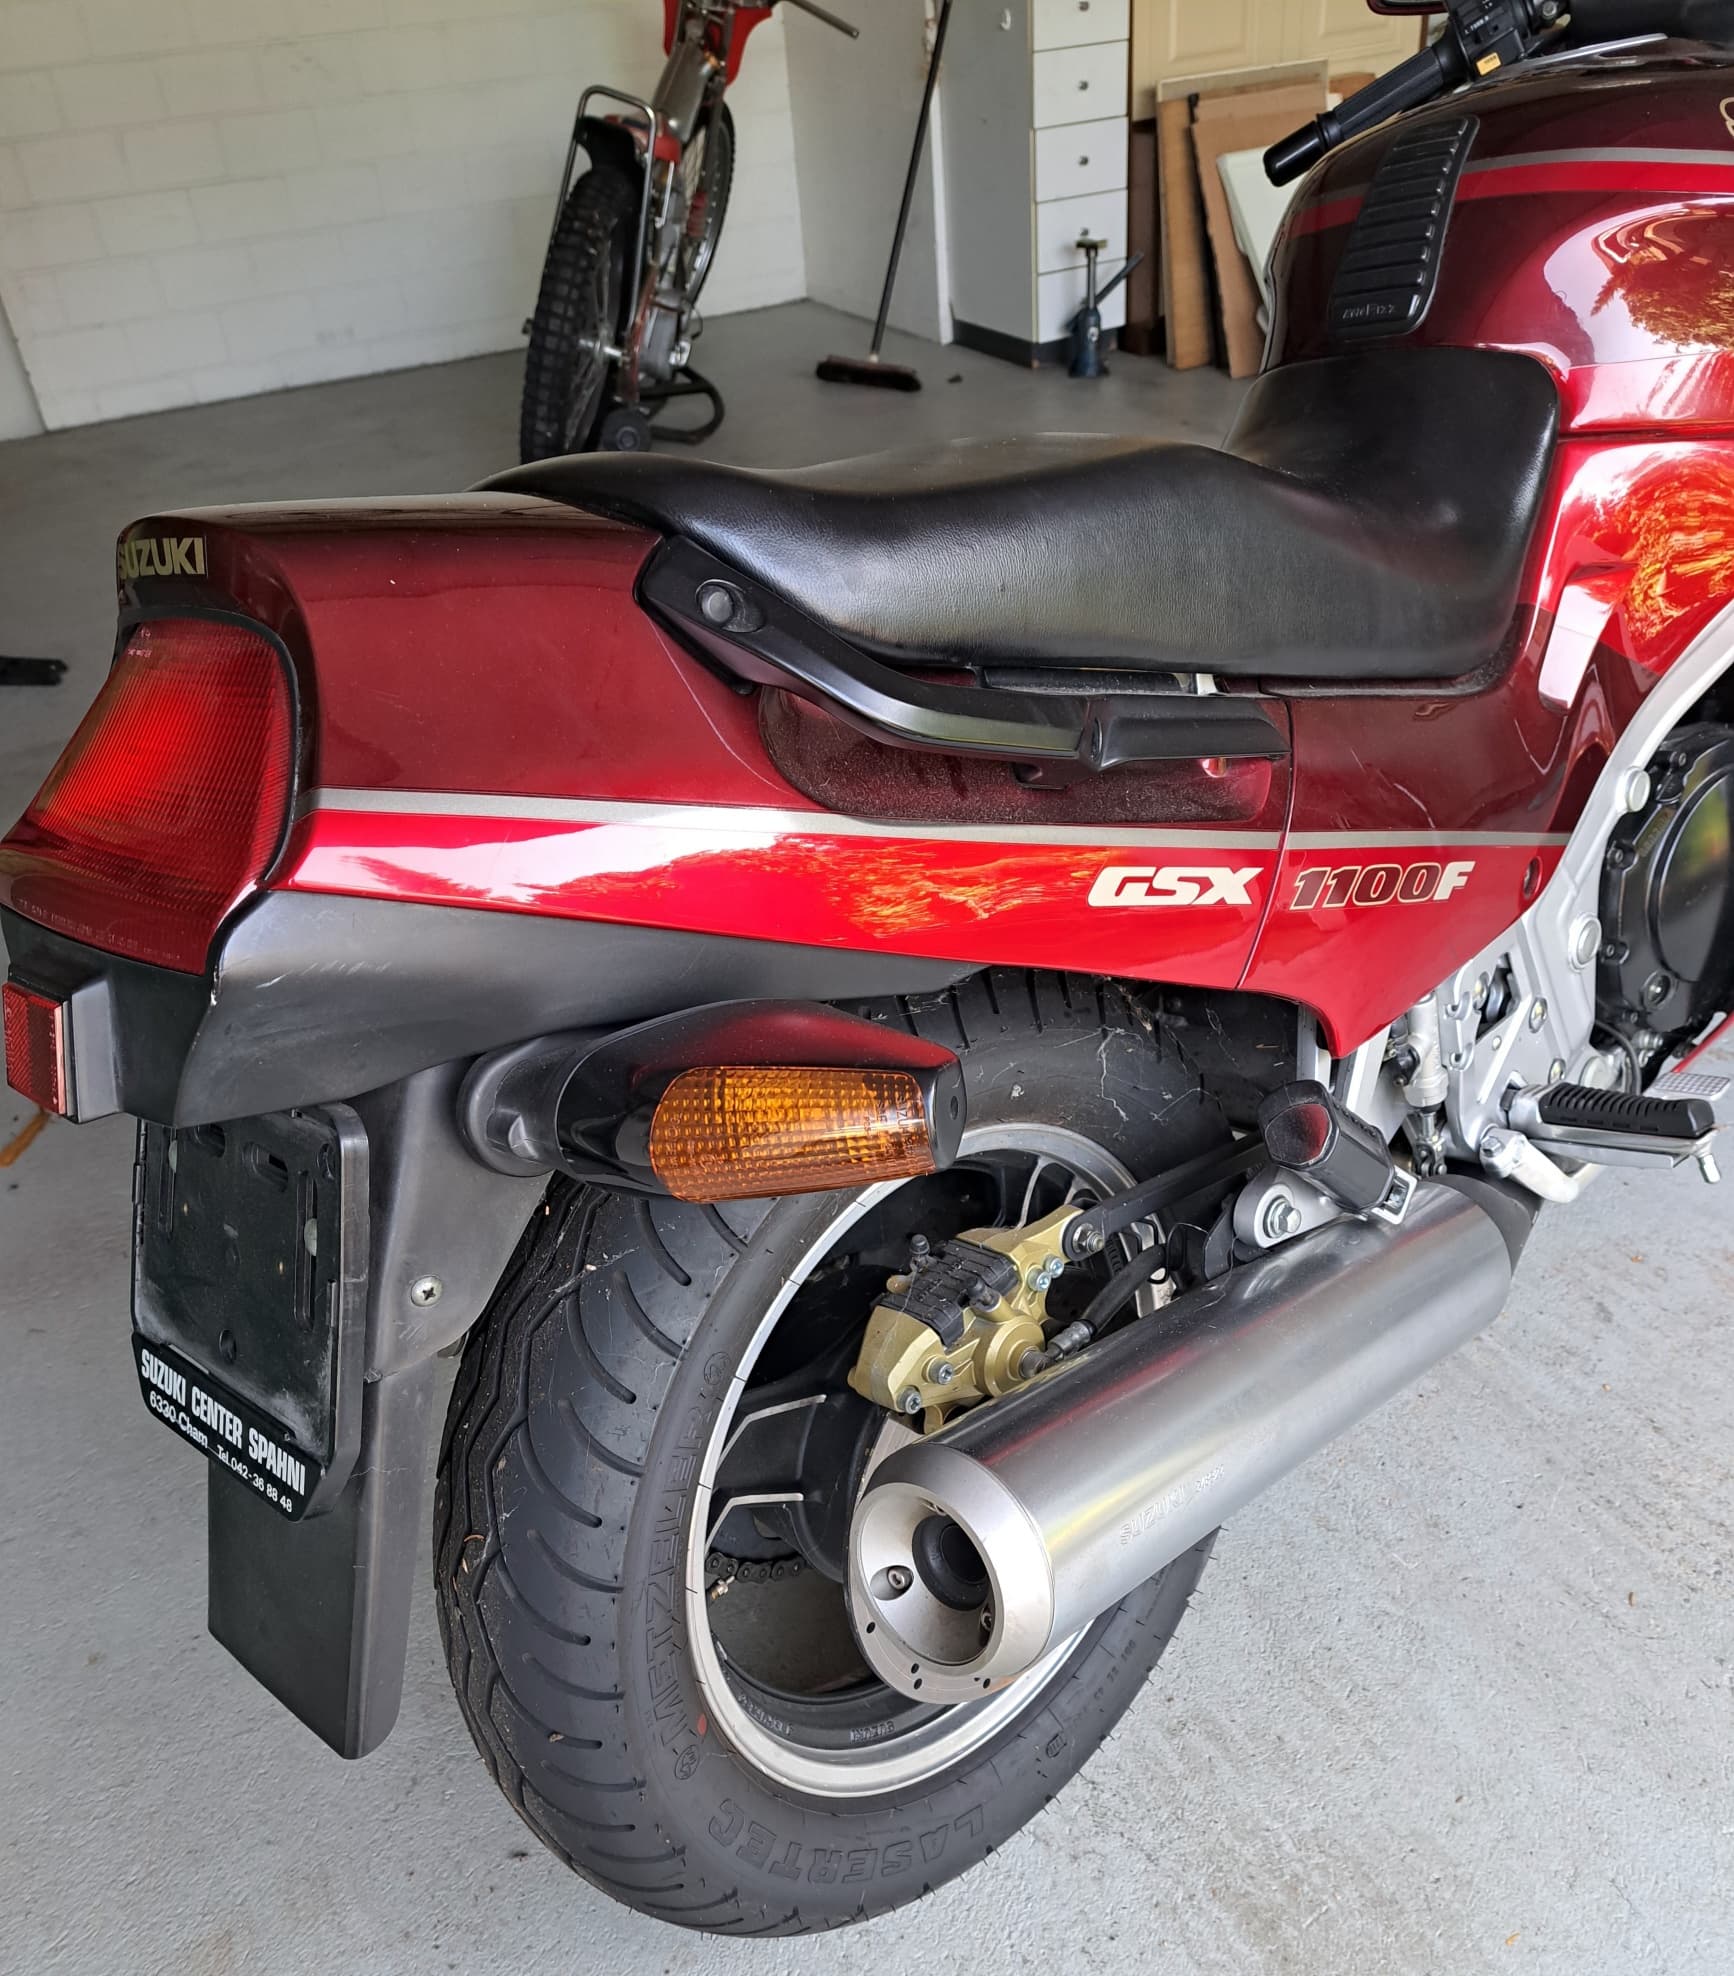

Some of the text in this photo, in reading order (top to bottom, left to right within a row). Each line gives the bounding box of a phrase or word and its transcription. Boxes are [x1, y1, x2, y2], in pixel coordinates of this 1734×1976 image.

[1087, 861, 1476, 911] GSX 1100F
[141, 1348, 306, 1496] SUZUKI CENTER SPAHNI
[150, 1390, 177, 1423] 6330
[178, 1411, 208, 1449] Cham
[266, 1483, 278, 1502] 88
[279, 1495, 293, 1513] 48
[647, 1407, 713, 1744] METZELER
[708, 1798, 984, 1884] LASERTEC
